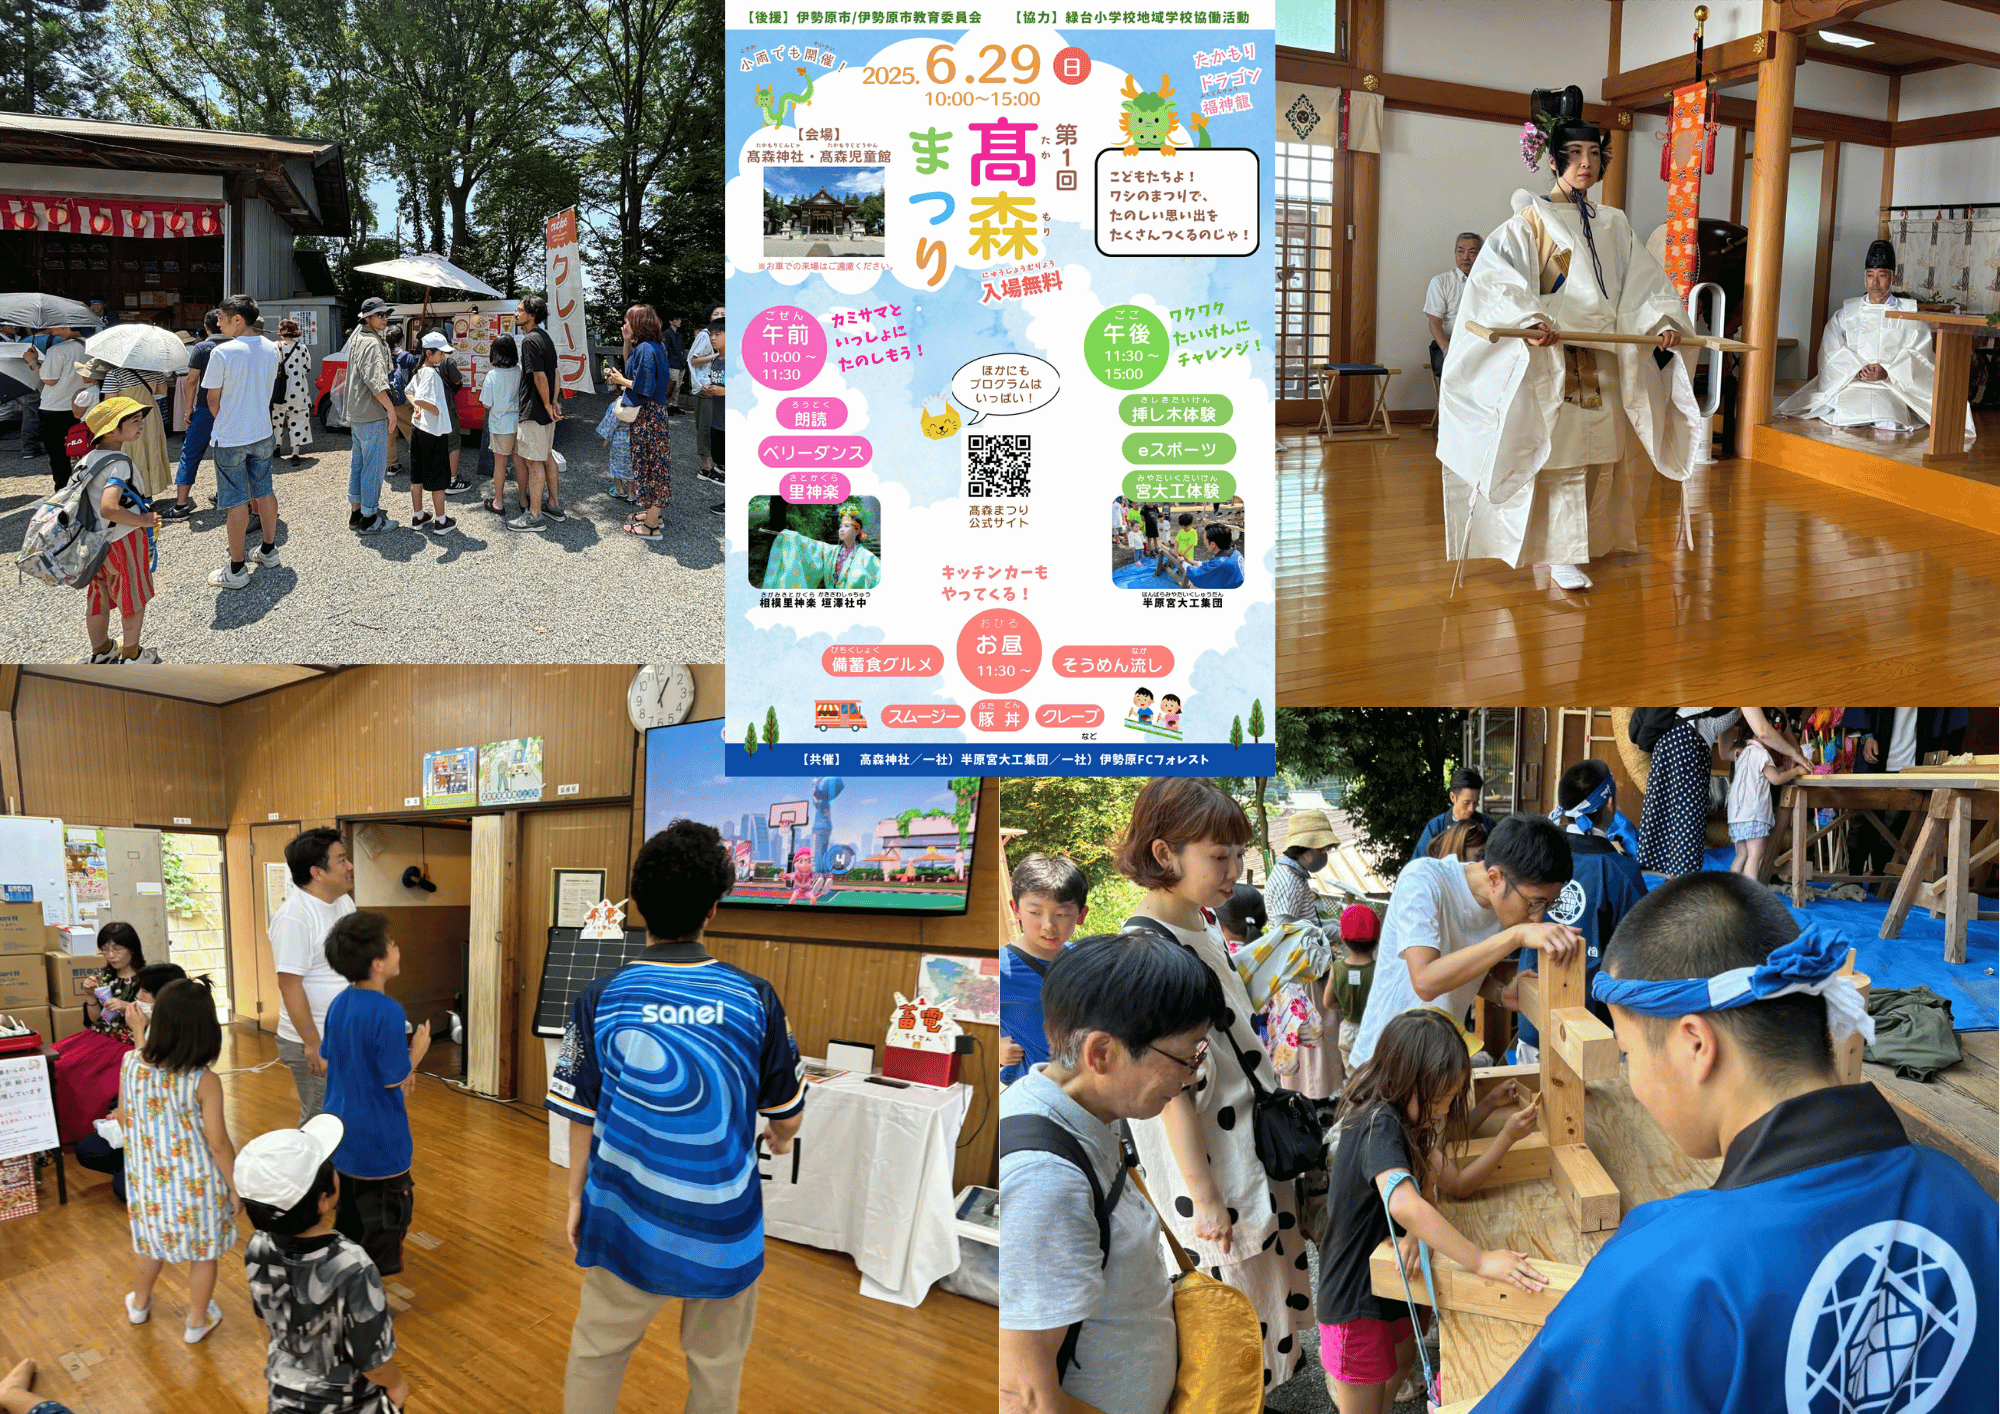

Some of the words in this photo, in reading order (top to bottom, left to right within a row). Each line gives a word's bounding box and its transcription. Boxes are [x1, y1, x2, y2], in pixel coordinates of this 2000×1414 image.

[750, 11, 787, 23] 【後援】
[797, 11, 982, 24] 伊勢原市/伊勢原市教育委員会
[1016, 11, 1056, 23] 【協力】
[1065, 11, 1250, 24] 緑台小学校地域学校協働活動
[1195, 43, 1255, 68] たかもり
[863, 67, 920, 85] 2025.
[926, 44, 1041, 85] 6.29
[1064, 58, 1080, 76] 日
[1200, 67, 1261, 91] ドラゴン
[1202, 94, 1251, 116] 福神龍
[798, 127, 840, 141] 【会場】
[908, 127, 956, 287] まつり
[1109, 209, 1218, 223] たのしい思い出を
[981, 268, 1064, 304] 入場無料
[552, 254, 587, 383] クレープ
[766, 310, 804, 321] ごぜん
[831, 303, 902, 329] カミサマと
[1114, 310, 1139, 320] ごご
[1169, 301, 1225, 324] ワクワク
[762, 323, 809, 346] 午前
[835, 325, 908, 349] いっしょに
[1103, 323, 1151, 346] 午後
[1172, 320, 1251, 346] たいけんに
[762, 369, 801, 381] 11:30
[982, 365, 1030, 377] ほかにも
[1104, 369, 1144, 381] 15:00
[970, 378, 1042, 391] プログラムは
[792, 400, 830, 409] ろうとく
[794, 411, 827, 427] 朗読
[1131, 407, 1217, 423] 挿し木体験
[763, 444, 864, 461] ベリーダンス
[1138, 441, 1216, 458] eスポーツ
[788, 484, 839, 500] 里神楽
[1135, 485, 1220, 500] 宮大工体験
[969, 517, 1029, 528] 公式サイト
[942, 564, 1048, 581] キッチンカーも
[759, 598, 816, 609] 相模里神楽
[821, 598, 867, 609] 垣澤社中
[1142, 598, 1223, 609] 半原宮大工集団
[979, 618, 1019, 629] おひる
[976, 634, 1023, 656] お昼
[831, 656, 932, 673] 備蓄食グルメ
[1062, 657, 1163, 674] そうめん流し
[639, 680, 648, 692] 10
[888, 709, 961, 725] スムージー
[1041, 708, 1100, 725] クレープ
[1081, 732, 1097, 741] など
[803, 753, 840, 766] 【共催】
[642, 1000, 725, 1025] sanei
